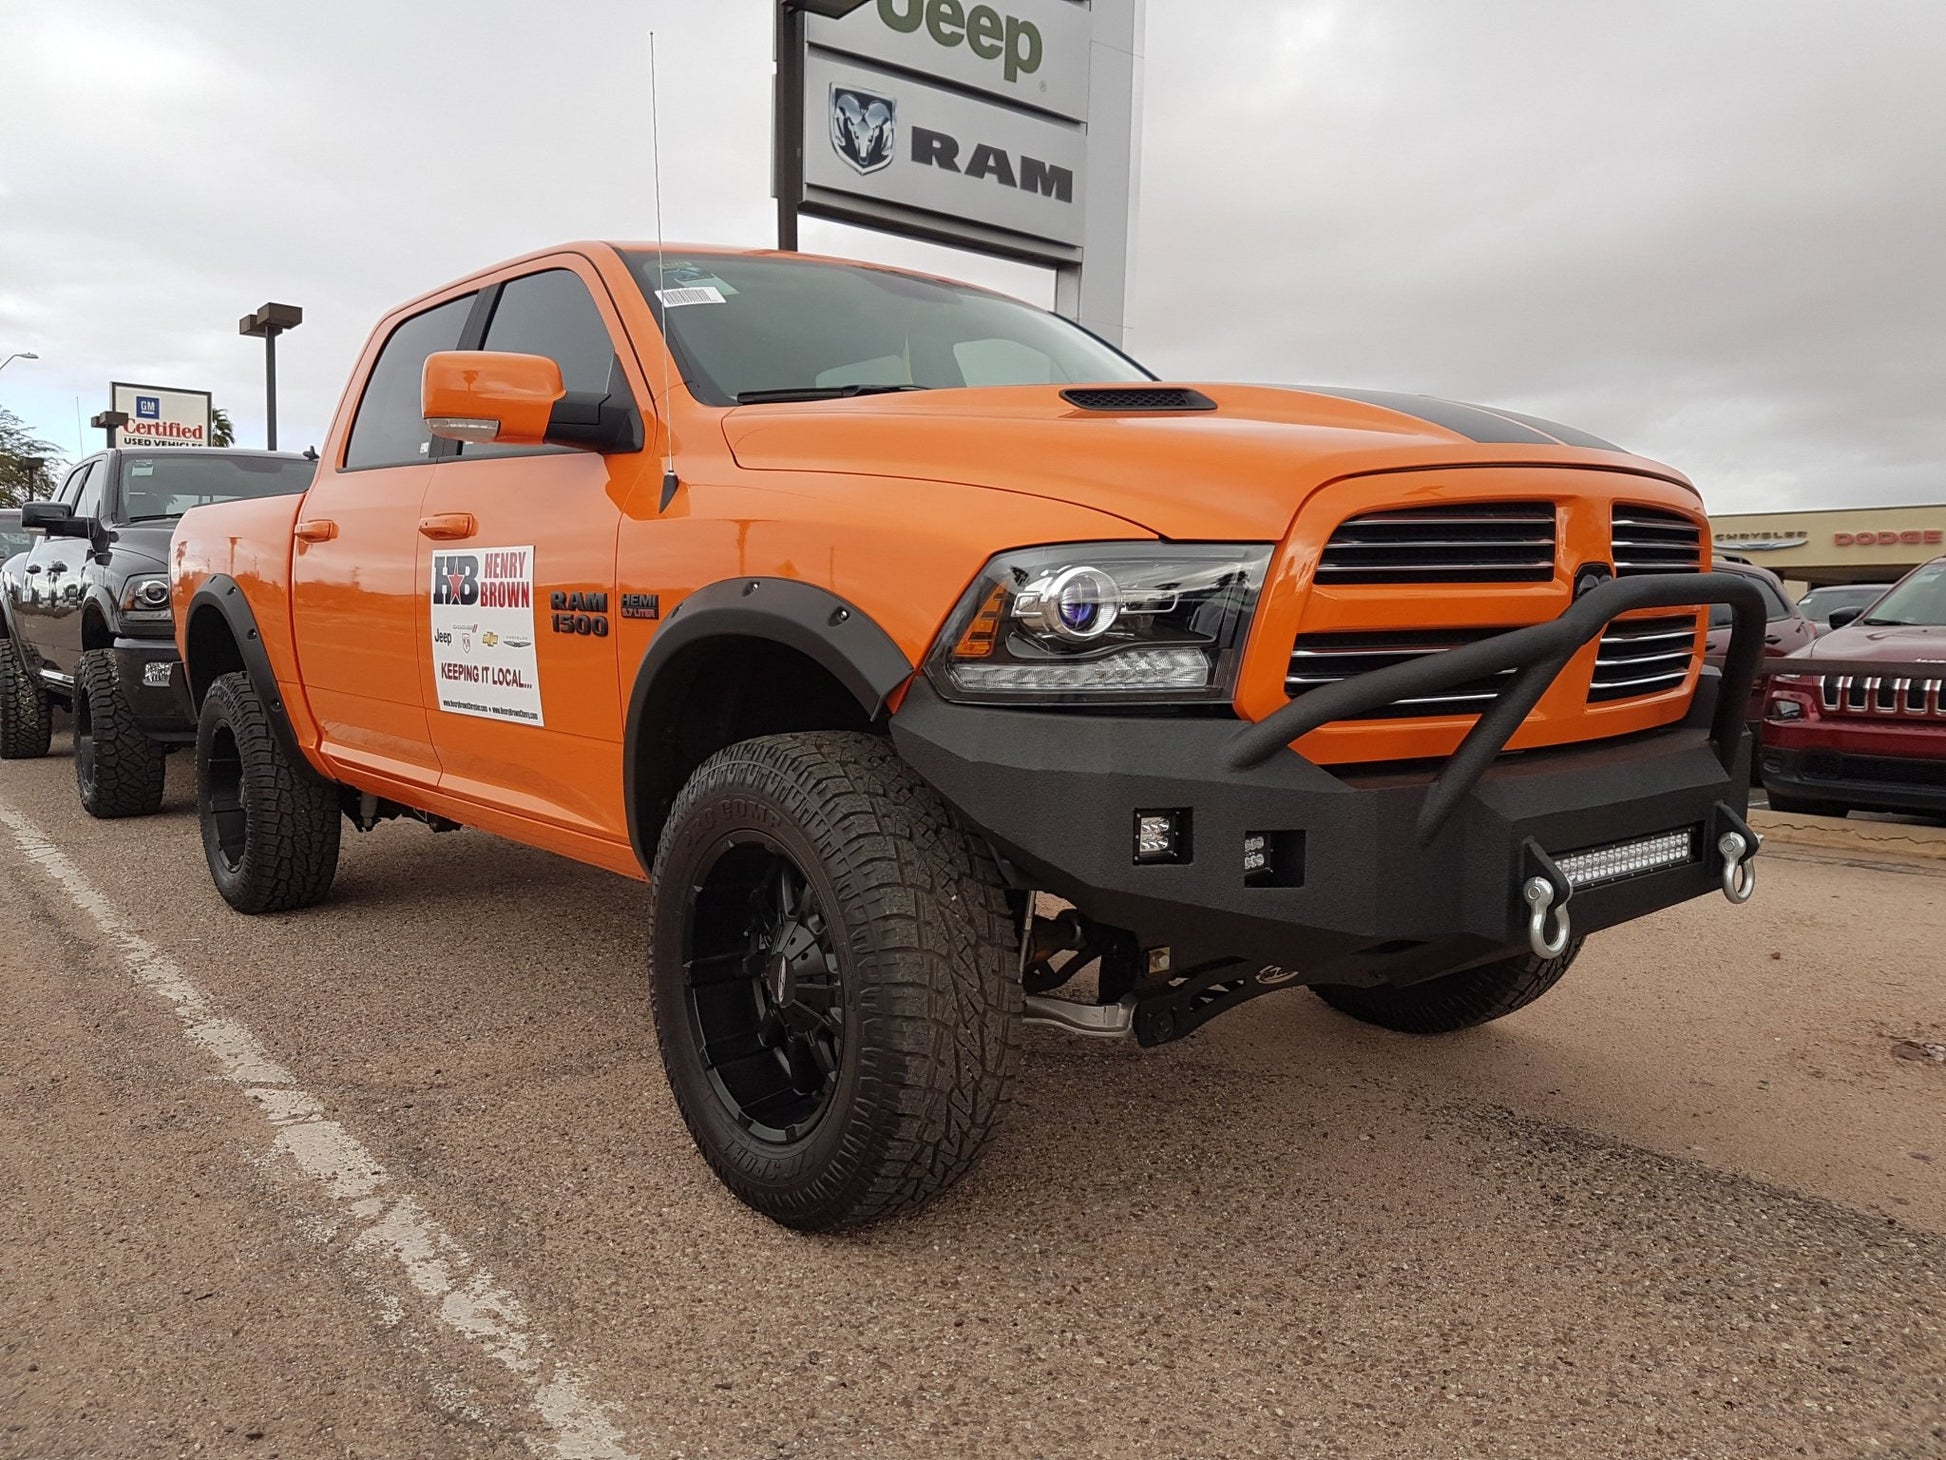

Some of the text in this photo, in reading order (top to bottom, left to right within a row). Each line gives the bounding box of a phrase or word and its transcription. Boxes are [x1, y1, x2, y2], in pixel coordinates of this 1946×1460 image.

[910, 125, 1073, 204] RAM
[140, 400, 155, 412] GM
[123, 418, 203, 440] Certified
[123, 437, 152, 446] USED
[1714, 530, 1808, 542] CHRYSLER
[1834, 529, 1943, 546] DODGE
[484, 551, 527, 579] HENRY
[480, 581, 530, 608] BROWN
[550, 590, 608, 613] RAM
[621, 593, 656, 608] HEMI
[551, 613, 609, 637] 1500
[434, 628, 453, 647] Jeep
[441, 661, 479, 683] KEEPING
[481, 666, 490, 684] IT
